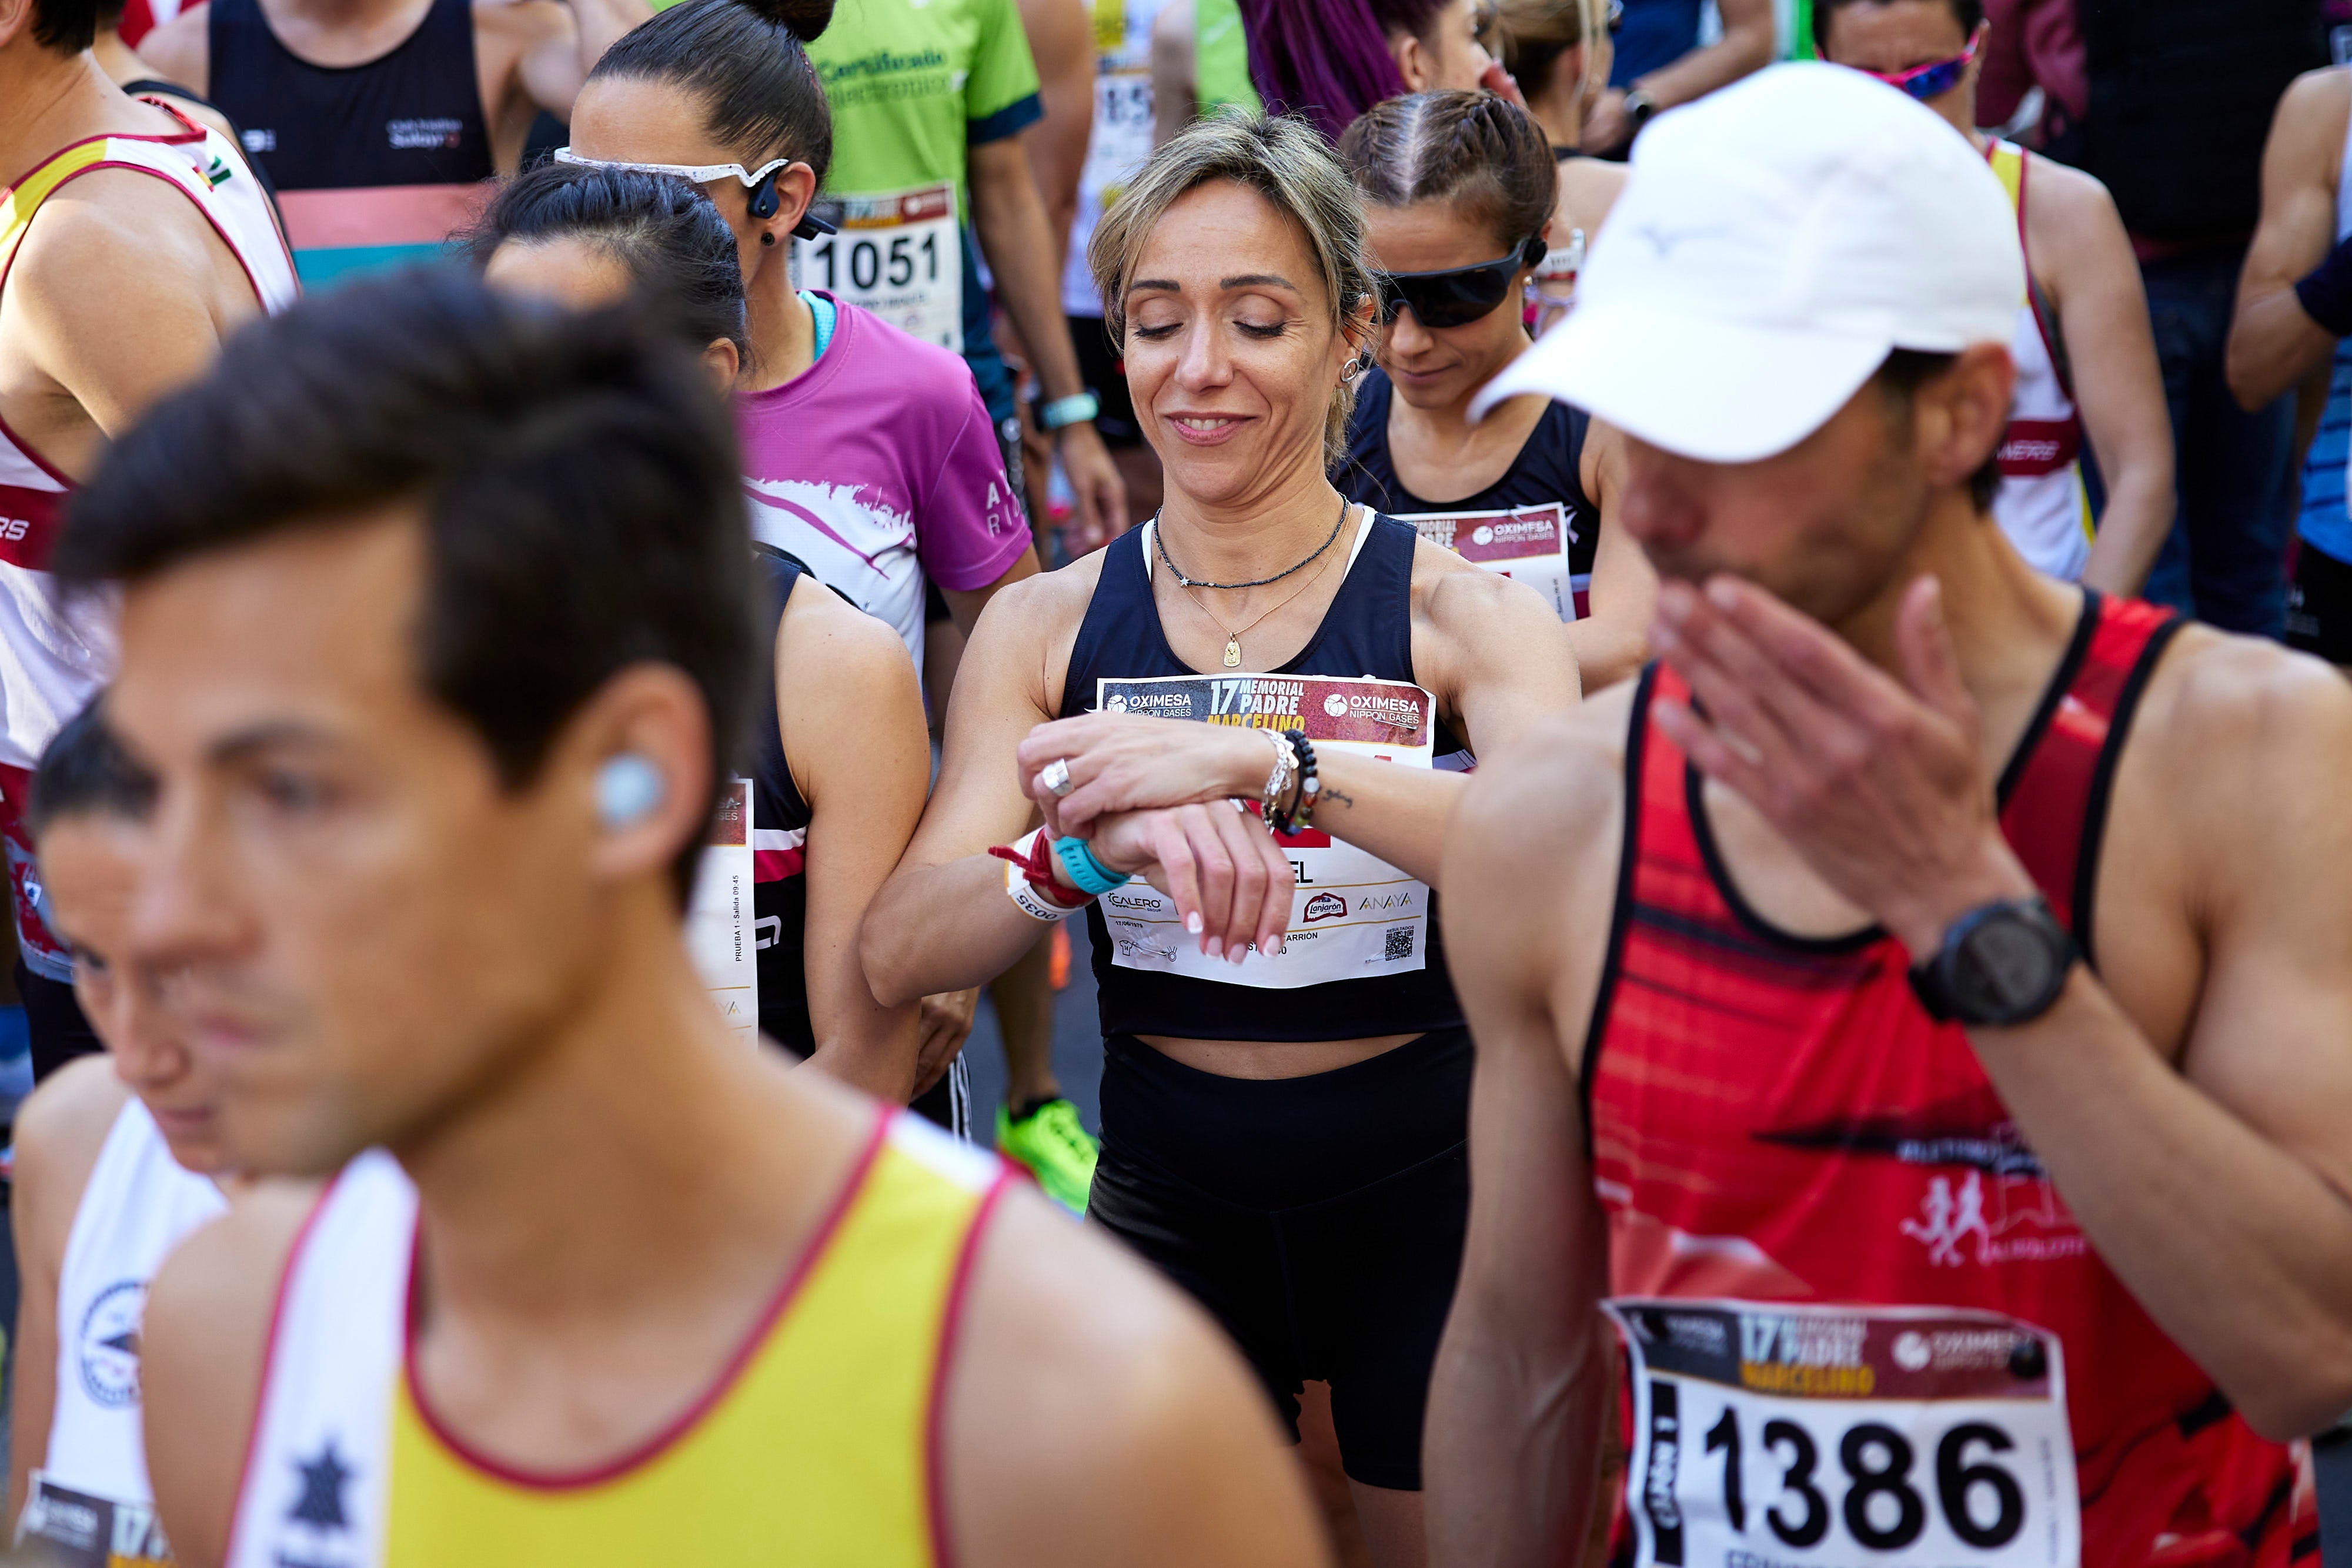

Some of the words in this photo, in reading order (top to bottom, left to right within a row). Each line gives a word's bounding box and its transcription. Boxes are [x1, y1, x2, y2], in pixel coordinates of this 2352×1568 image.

[816, 232, 937, 289] 1051
[1494, 520, 1554, 536] OXIMESA
[1239, 680, 1304, 696] MEMORIAL
[1130, 694, 1192, 707] OXIMESA
[1210, 680, 1241, 715] 17
[1240, 694, 1299, 716] PADRE
[1350, 696, 1419, 713] OXIMESA
[1163, 708, 1191, 717] GASES
[1349, 710, 1386, 720] NIPPON
[1389, 713, 1419, 724] GASES
[1016, 895, 1057, 920] 0035
[1110, 894, 1161, 909] CALERO
[1309, 903, 1341, 914] Lanjarón
[1359, 892, 1413, 910] ANAYA
[1284, 931, 1318, 942] ARRIÓN
[1739, 1315, 1780, 1363] 17
[1704, 1405, 2025, 1553] 1386
